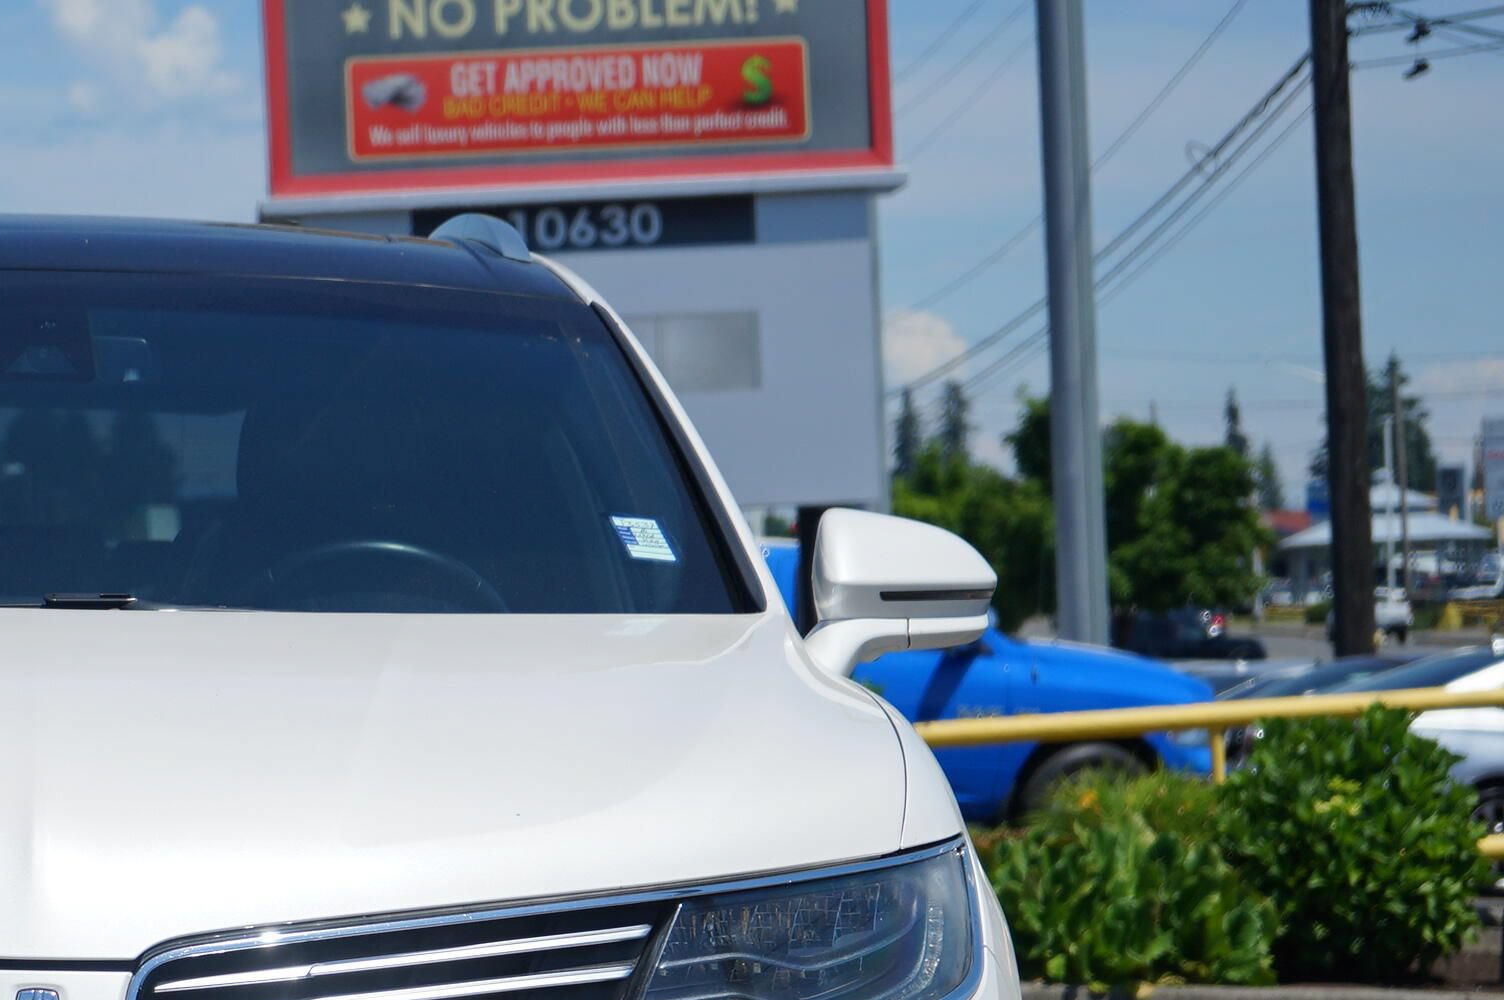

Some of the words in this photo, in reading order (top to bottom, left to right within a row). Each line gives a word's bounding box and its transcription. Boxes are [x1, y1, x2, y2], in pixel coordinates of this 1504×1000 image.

[388, 0, 477, 39] NO
[449, 61, 498, 97] GET
[503, 55, 635, 94] APPROVED
[642, 52, 703, 88] NOW
[443, 95, 487, 119] BAD
[489, 91, 562, 117] CREDIT
[575, 91, 607, 113] WE
[612, 89, 656, 112] CAN
[659, 84, 713, 109] HELP
[369, 125, 394, 146] We
[470, 119, 528, 142] vehicles
[548, 117, 593, 143] people
[597, 113, 626, 135] with
[630, 113, 657, 133] less
[660, 111, 690, 132] than
[694, 108, 742, 135] perfect
[508, 203, 663, 248] 10630
